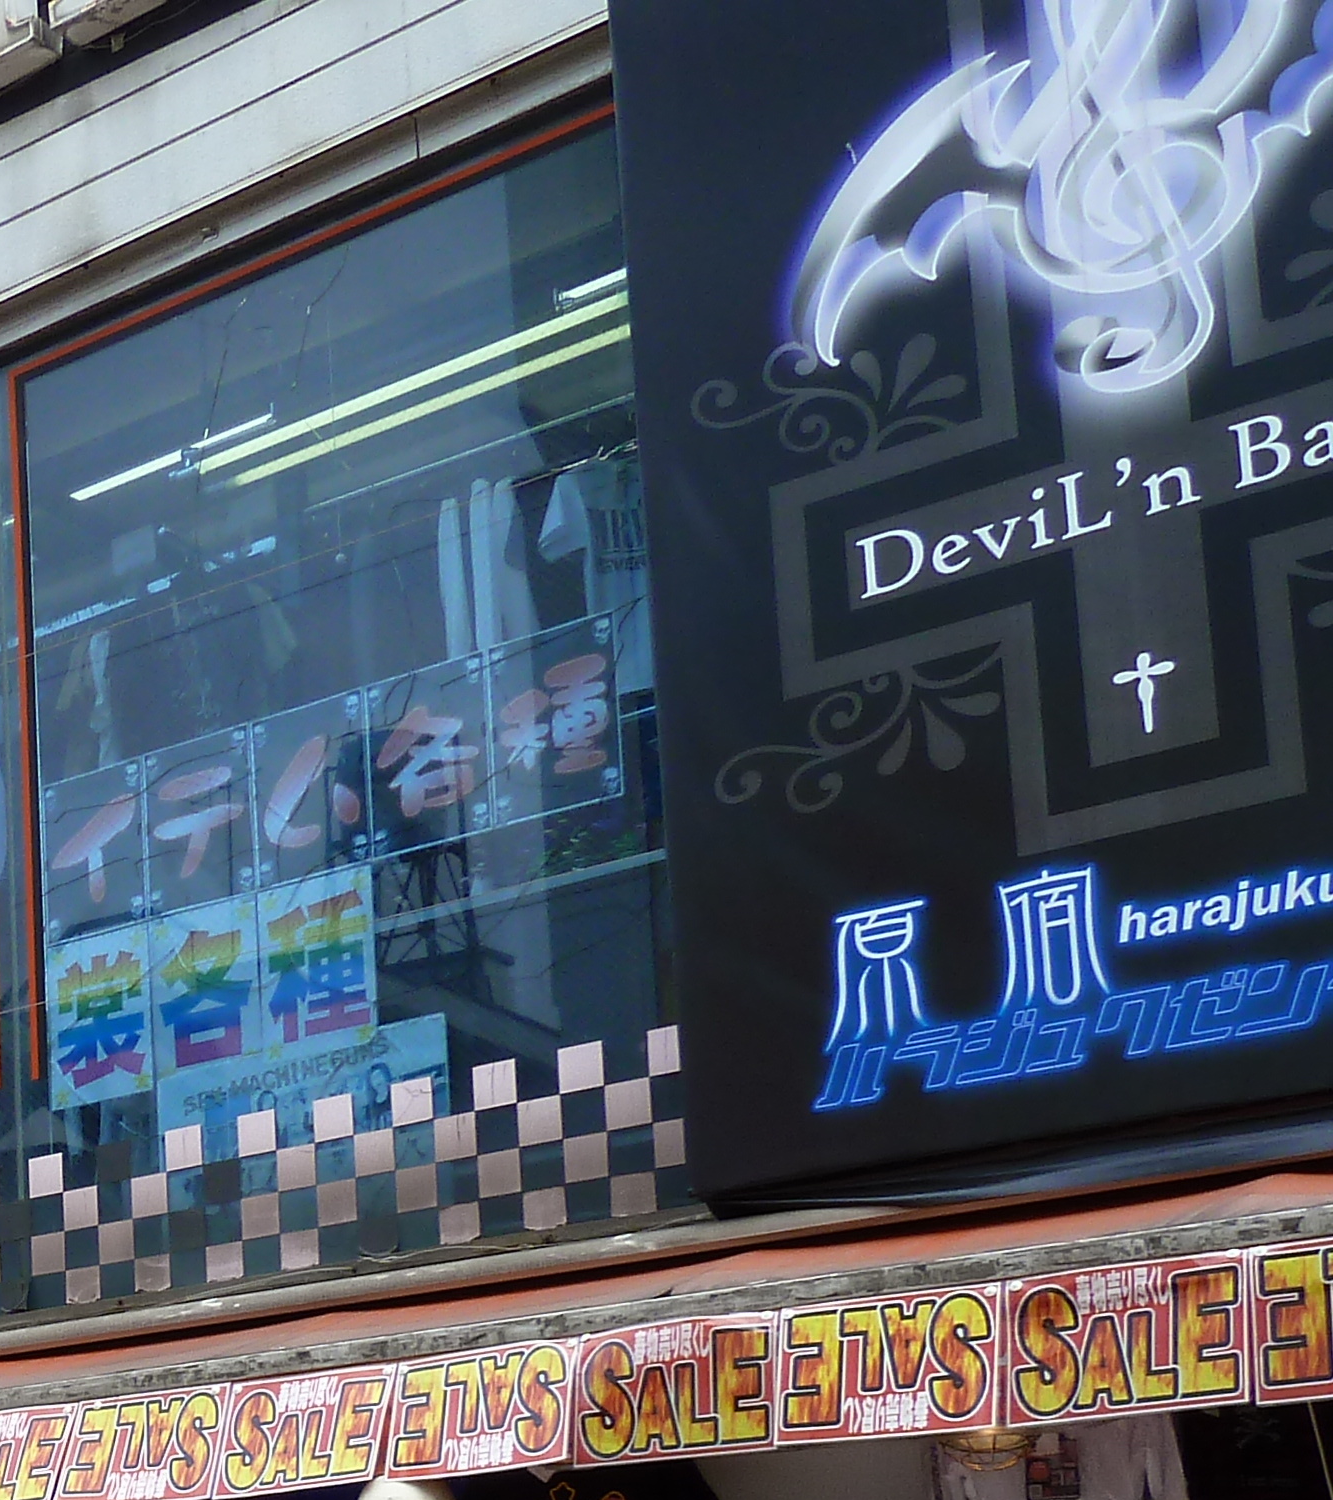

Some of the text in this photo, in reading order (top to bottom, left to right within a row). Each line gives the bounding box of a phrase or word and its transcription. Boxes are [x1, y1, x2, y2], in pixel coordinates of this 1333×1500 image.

[855, 458, 1201, 600] DeviL'n
[813, 962, 1333, 1114] ハラジュクゼン
[392, 1345, 568, 1468] SALE
[581, 1325, 772, 1459] SALE
[782, 1292, 992, 1428] SALE
[1015, 1265, 1242, 1417] SALE
[66, 1393, 220, 1495] SALE
[225, 1377, 388, 1490] SALE
